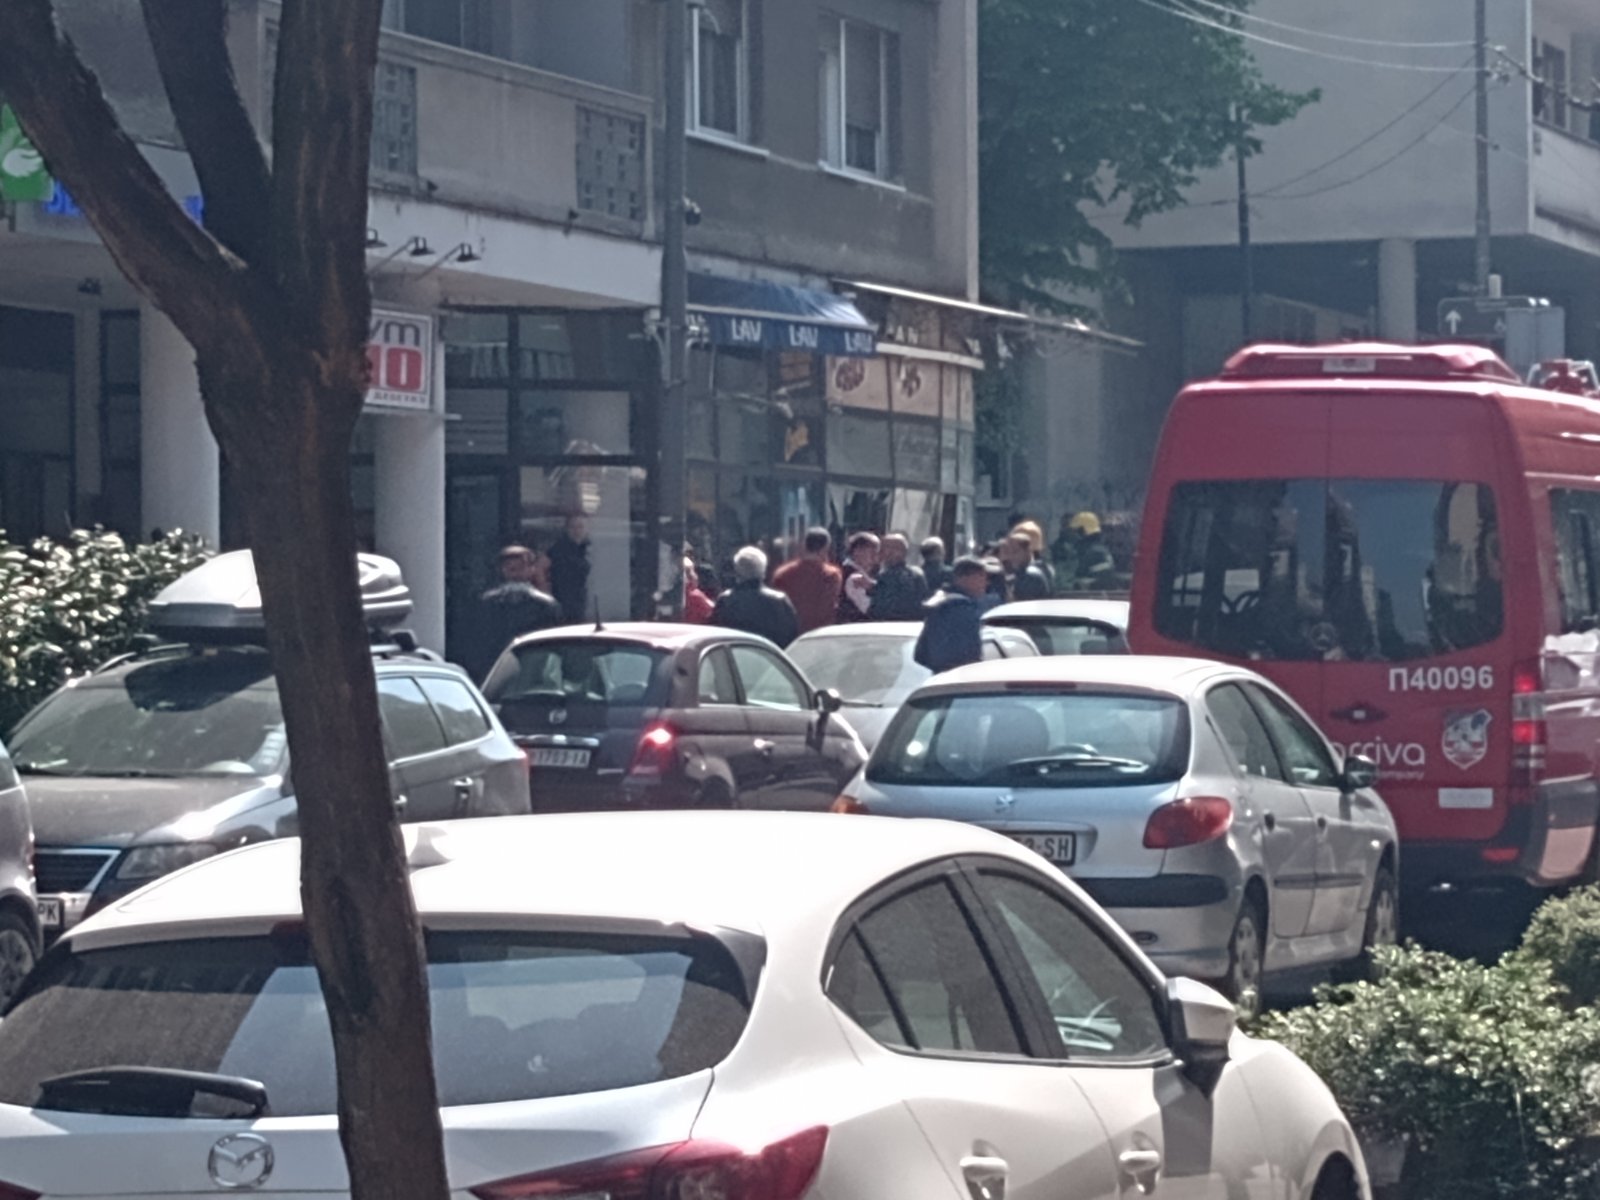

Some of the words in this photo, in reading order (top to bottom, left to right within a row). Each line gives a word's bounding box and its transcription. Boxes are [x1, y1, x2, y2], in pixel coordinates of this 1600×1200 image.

[731, 318, 762, 343] LAV
[788, 324, 819, 349] LAV
[1388, 665, 1494, 692] П40096
